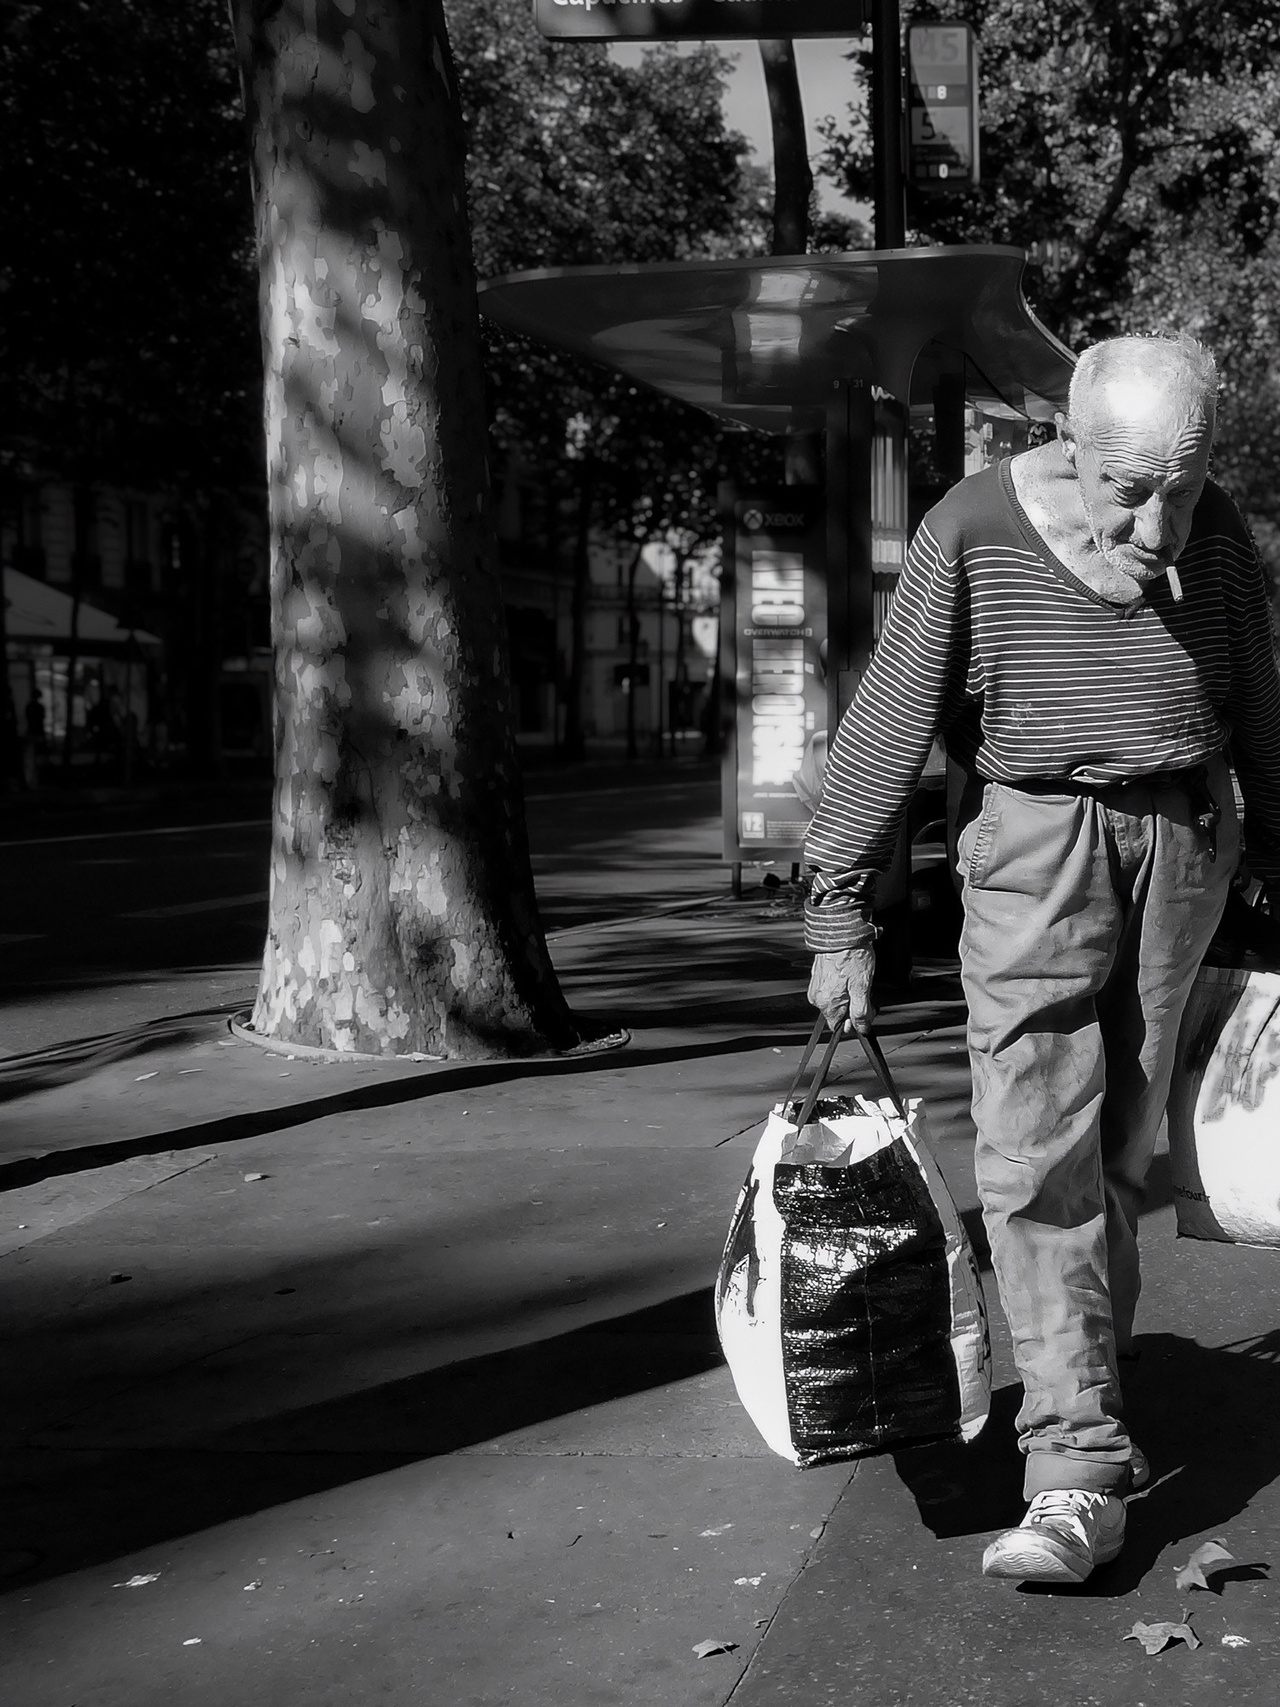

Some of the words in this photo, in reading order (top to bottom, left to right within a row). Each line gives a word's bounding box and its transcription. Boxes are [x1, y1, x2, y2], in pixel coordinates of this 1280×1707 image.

[833, 379, 840, 389] 9
[764, 513, 805, 527] XBOX
[743, 628, 804, 636] OVERWATCH
[743, 813, 763, 832] 12
